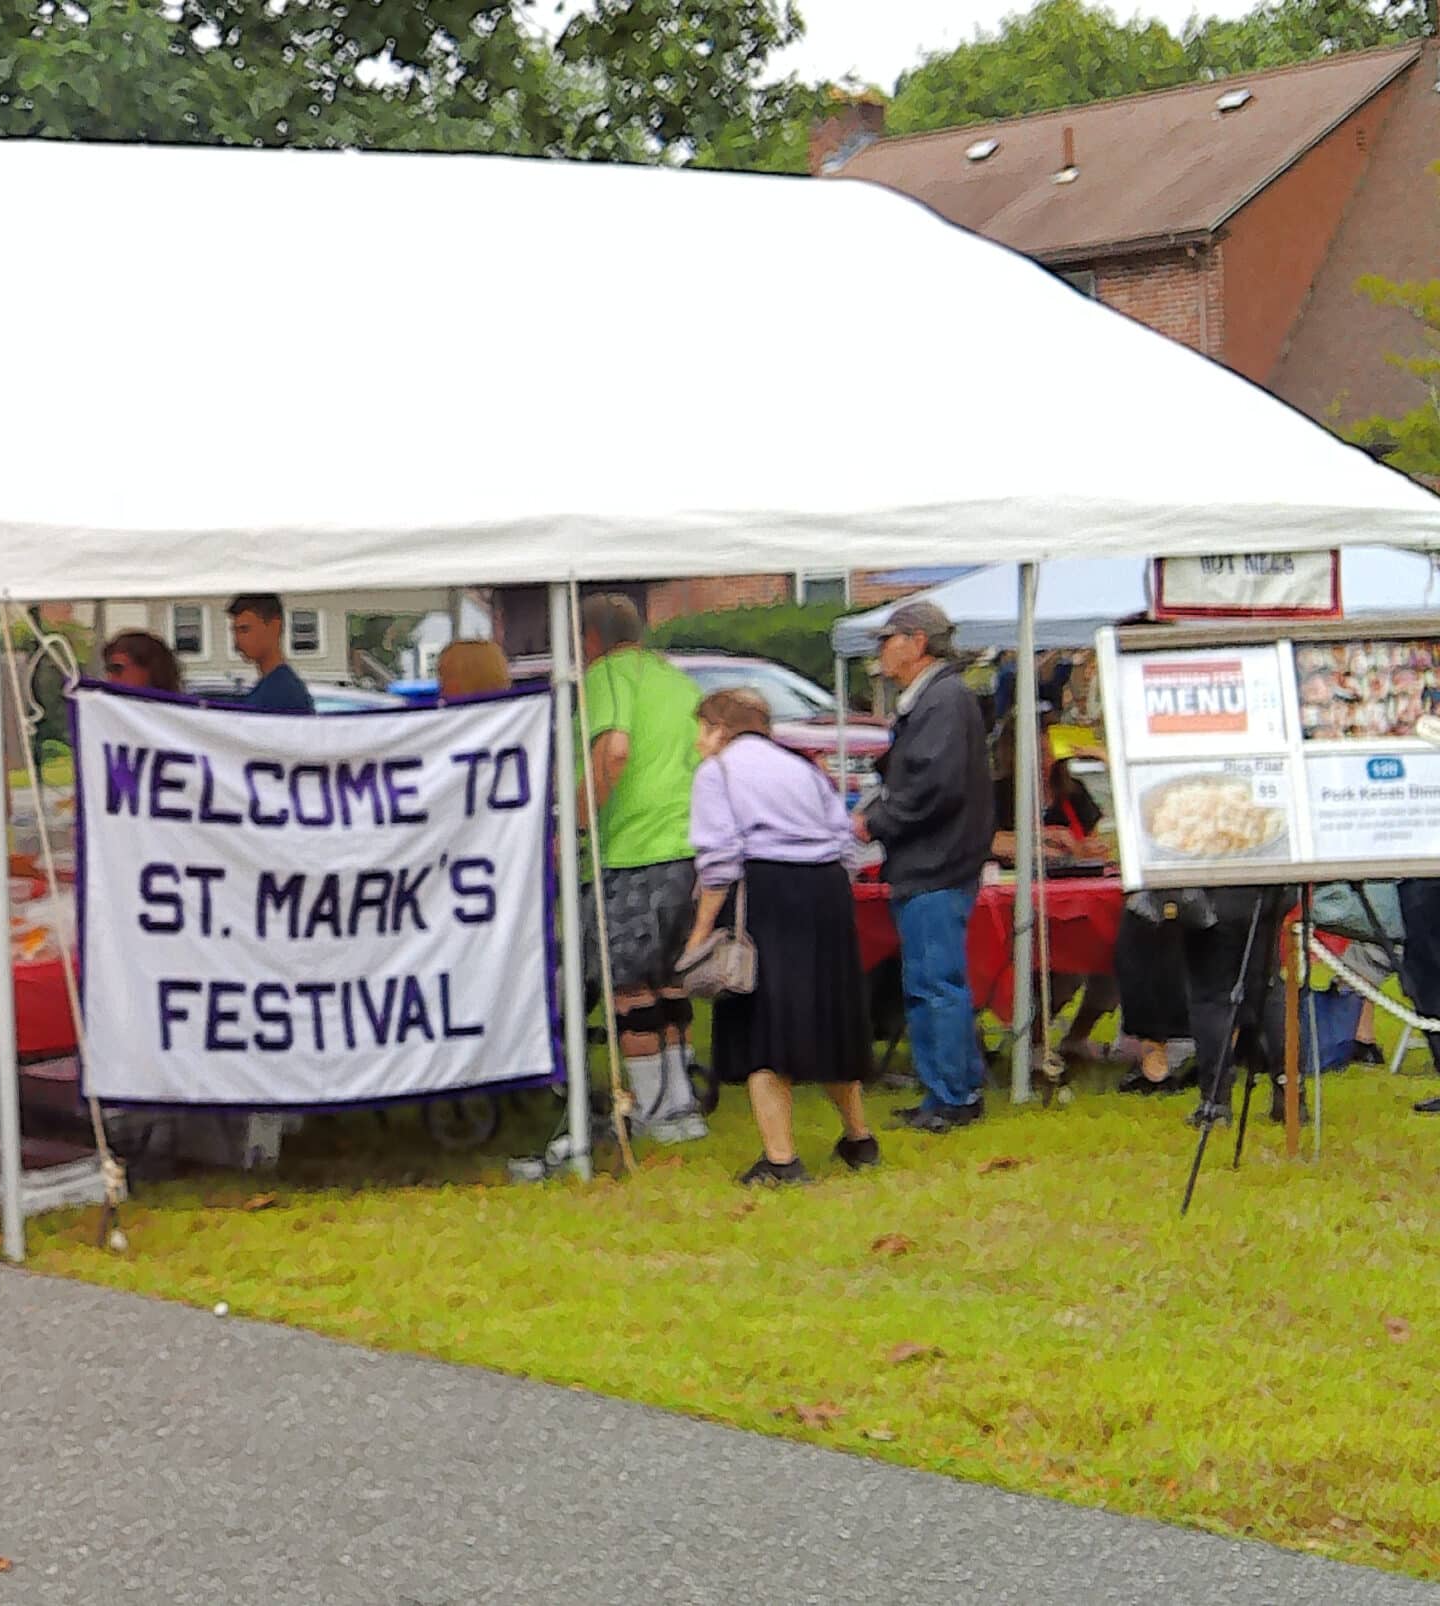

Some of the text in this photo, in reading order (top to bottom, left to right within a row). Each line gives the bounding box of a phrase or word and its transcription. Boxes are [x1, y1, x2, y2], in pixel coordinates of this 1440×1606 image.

[1146, 684, 1244, 714] MENU
[103, 742, 531, 827] WELCOME TO
[138, 849, 497, 940] ST. MARK'S
[157, 972, 484, 1052] FESTIVAL
